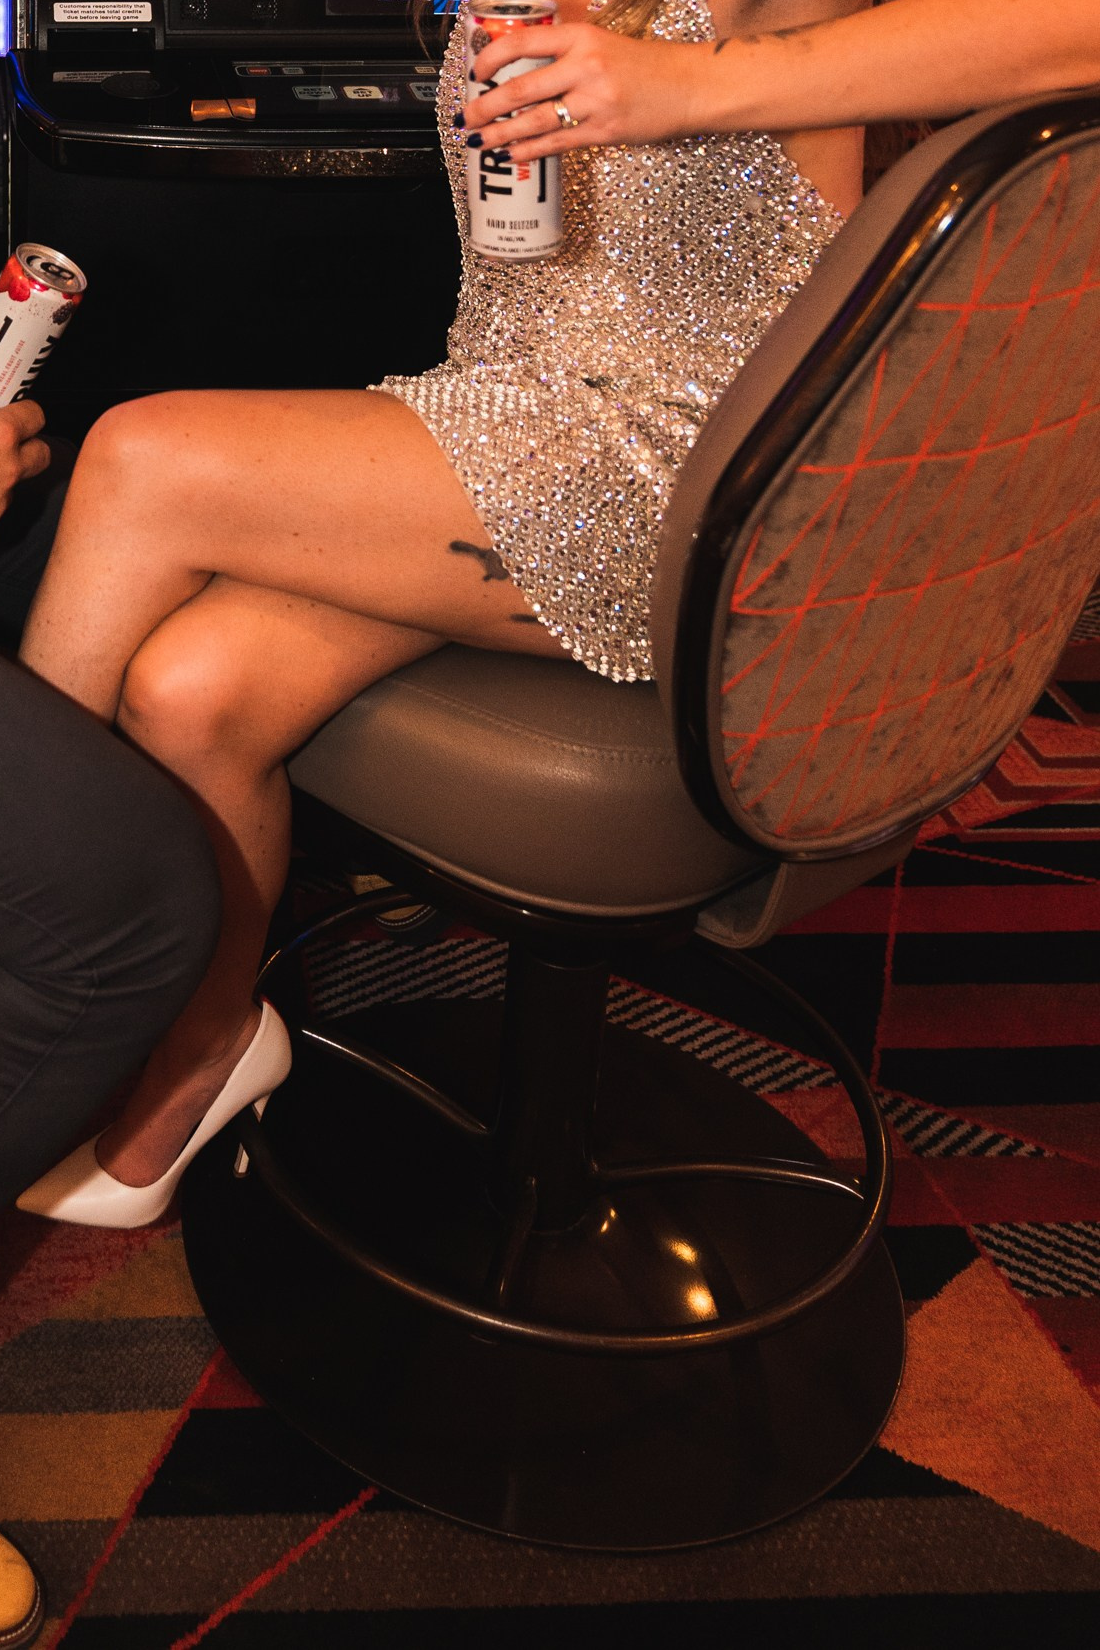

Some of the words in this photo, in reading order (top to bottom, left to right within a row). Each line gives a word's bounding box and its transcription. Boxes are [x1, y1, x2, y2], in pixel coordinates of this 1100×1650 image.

[485, 218, 505, 230] HARD
[509, 218, 539, 231] SELTZER
[5, 354, 16, 370] FRUIT
